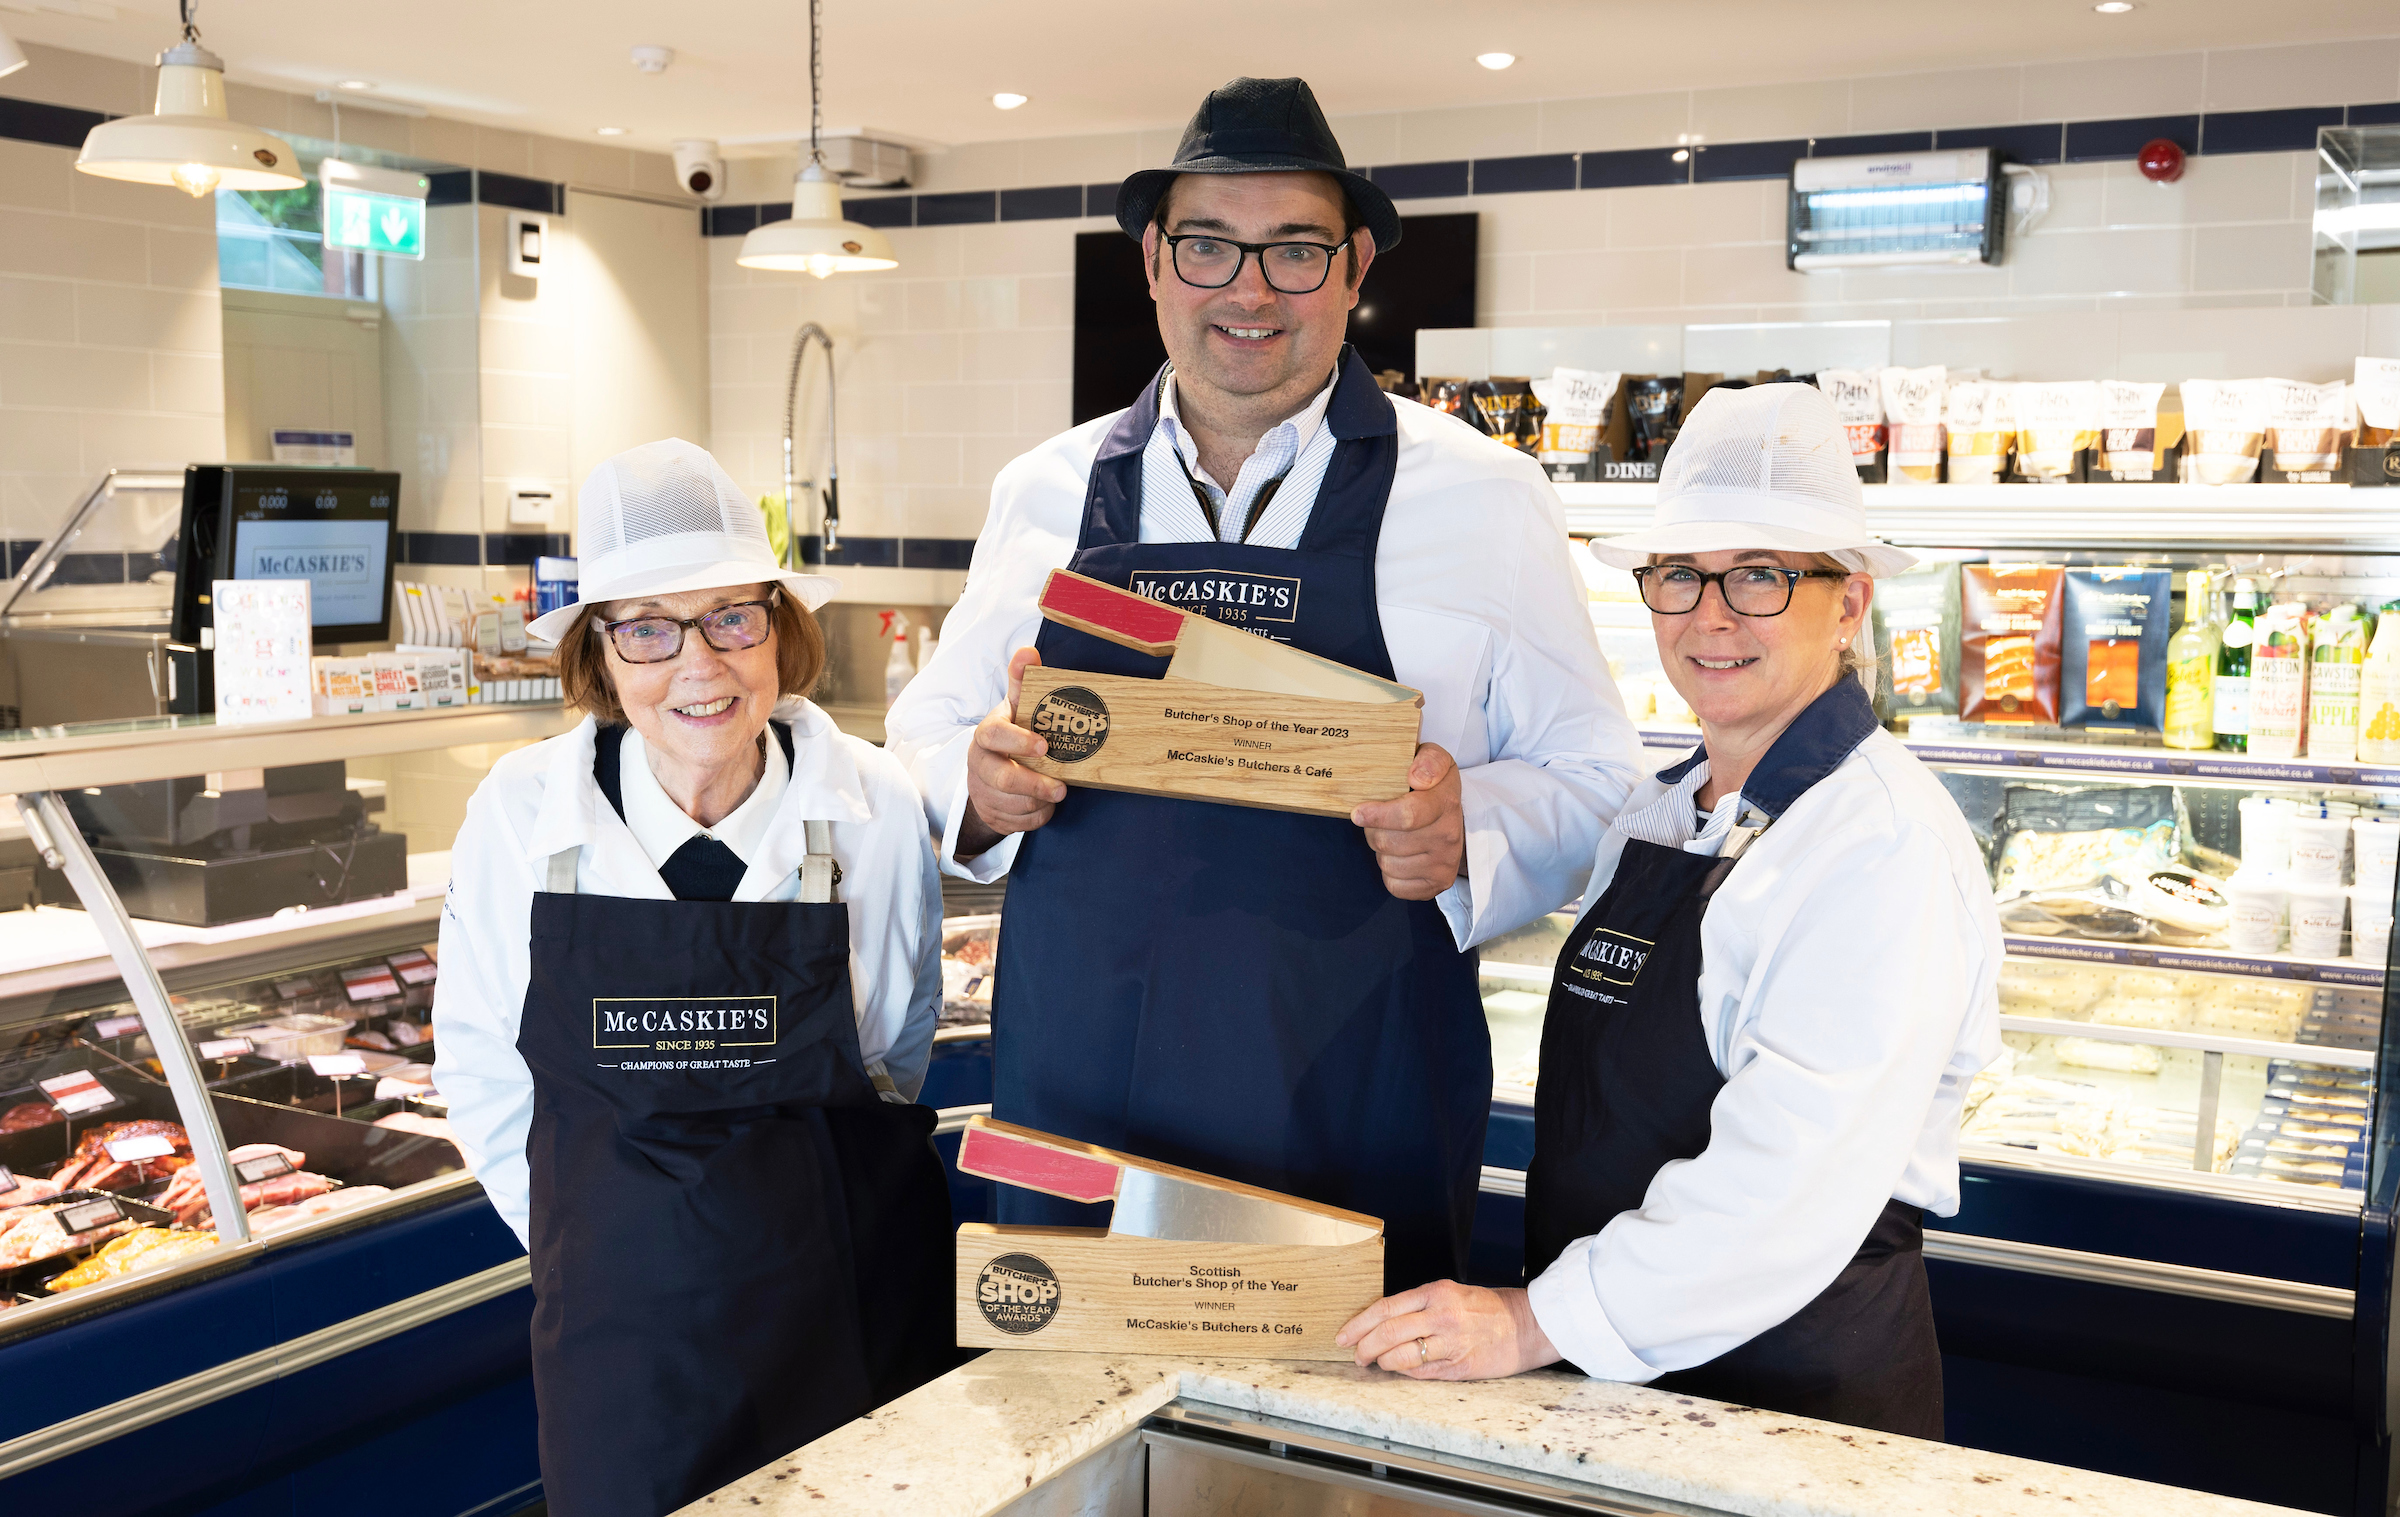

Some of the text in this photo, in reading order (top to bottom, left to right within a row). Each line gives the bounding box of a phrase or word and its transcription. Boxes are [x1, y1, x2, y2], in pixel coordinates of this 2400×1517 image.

[1604, 461, 1657, 479] DINE
[258, 495, 288, 509] 0.000
[315, 495, 338, 509] 0.00
[258, 553, 366, 575] McCASKIE'S
[1135, 579, 1290, 608] McCASKIE'S
[1218, 606, 1248, 621] 1935
[330, 674, 359, 685] HONEY
[375, 669, 403, 681] SWEET
[1050, 696, 1100, 720] BUTCHER'S
[2311, 704, 2359, 726] APPLE
[1034, 711, 1107, 736] SHOP
[1164, 708, 1349, 739] Butcher's Shop of the Year 2023
[1048, 741, 1088, 753] AWARDS
[1053, 733, 1071, 743] THE
[1072, 736, 1099, 746] YEAR
[1233, 738, 1272, 750] WINNER
[1167, 749, 1333, 778] McCaskie's Butchers & Café
[2043, 755, 2154, 770] www.mccaskiebutcher.co.uk
[2197, 764, 2314, 780] www.mccaskiebutcher.co.uk
[2005, 943, 2116, 962] www.mccaskiebutcher.co.uk
[2158, 956, 2273, 975] www.mccaskiebutcher.co.uk
[604, 1008, 768, 1032] McCASKIE'S
[655, 1040, 716, 1050] SINCE 1935
[620, 1059, 751, 1071] CHAMPIONS OF GREAT TASTE
[992, 1265, 1049, 1287] BUTCHER'S
[1189, 1265, 1241, 1277] Scottish
[1133, 1275, 1299, 1292] Butcher's Shop of the Year
[979, 1280, 1058, 1305] SHOP
[986, 1304, 1051, 1315] OF THE YEAR
[1194, 1301, 1236, 1311] WINNER
[995, 1312, 1042, 1322] AWARDS
[1126, 1318, 1303, 1335] McCaskie's Butchers & Café
